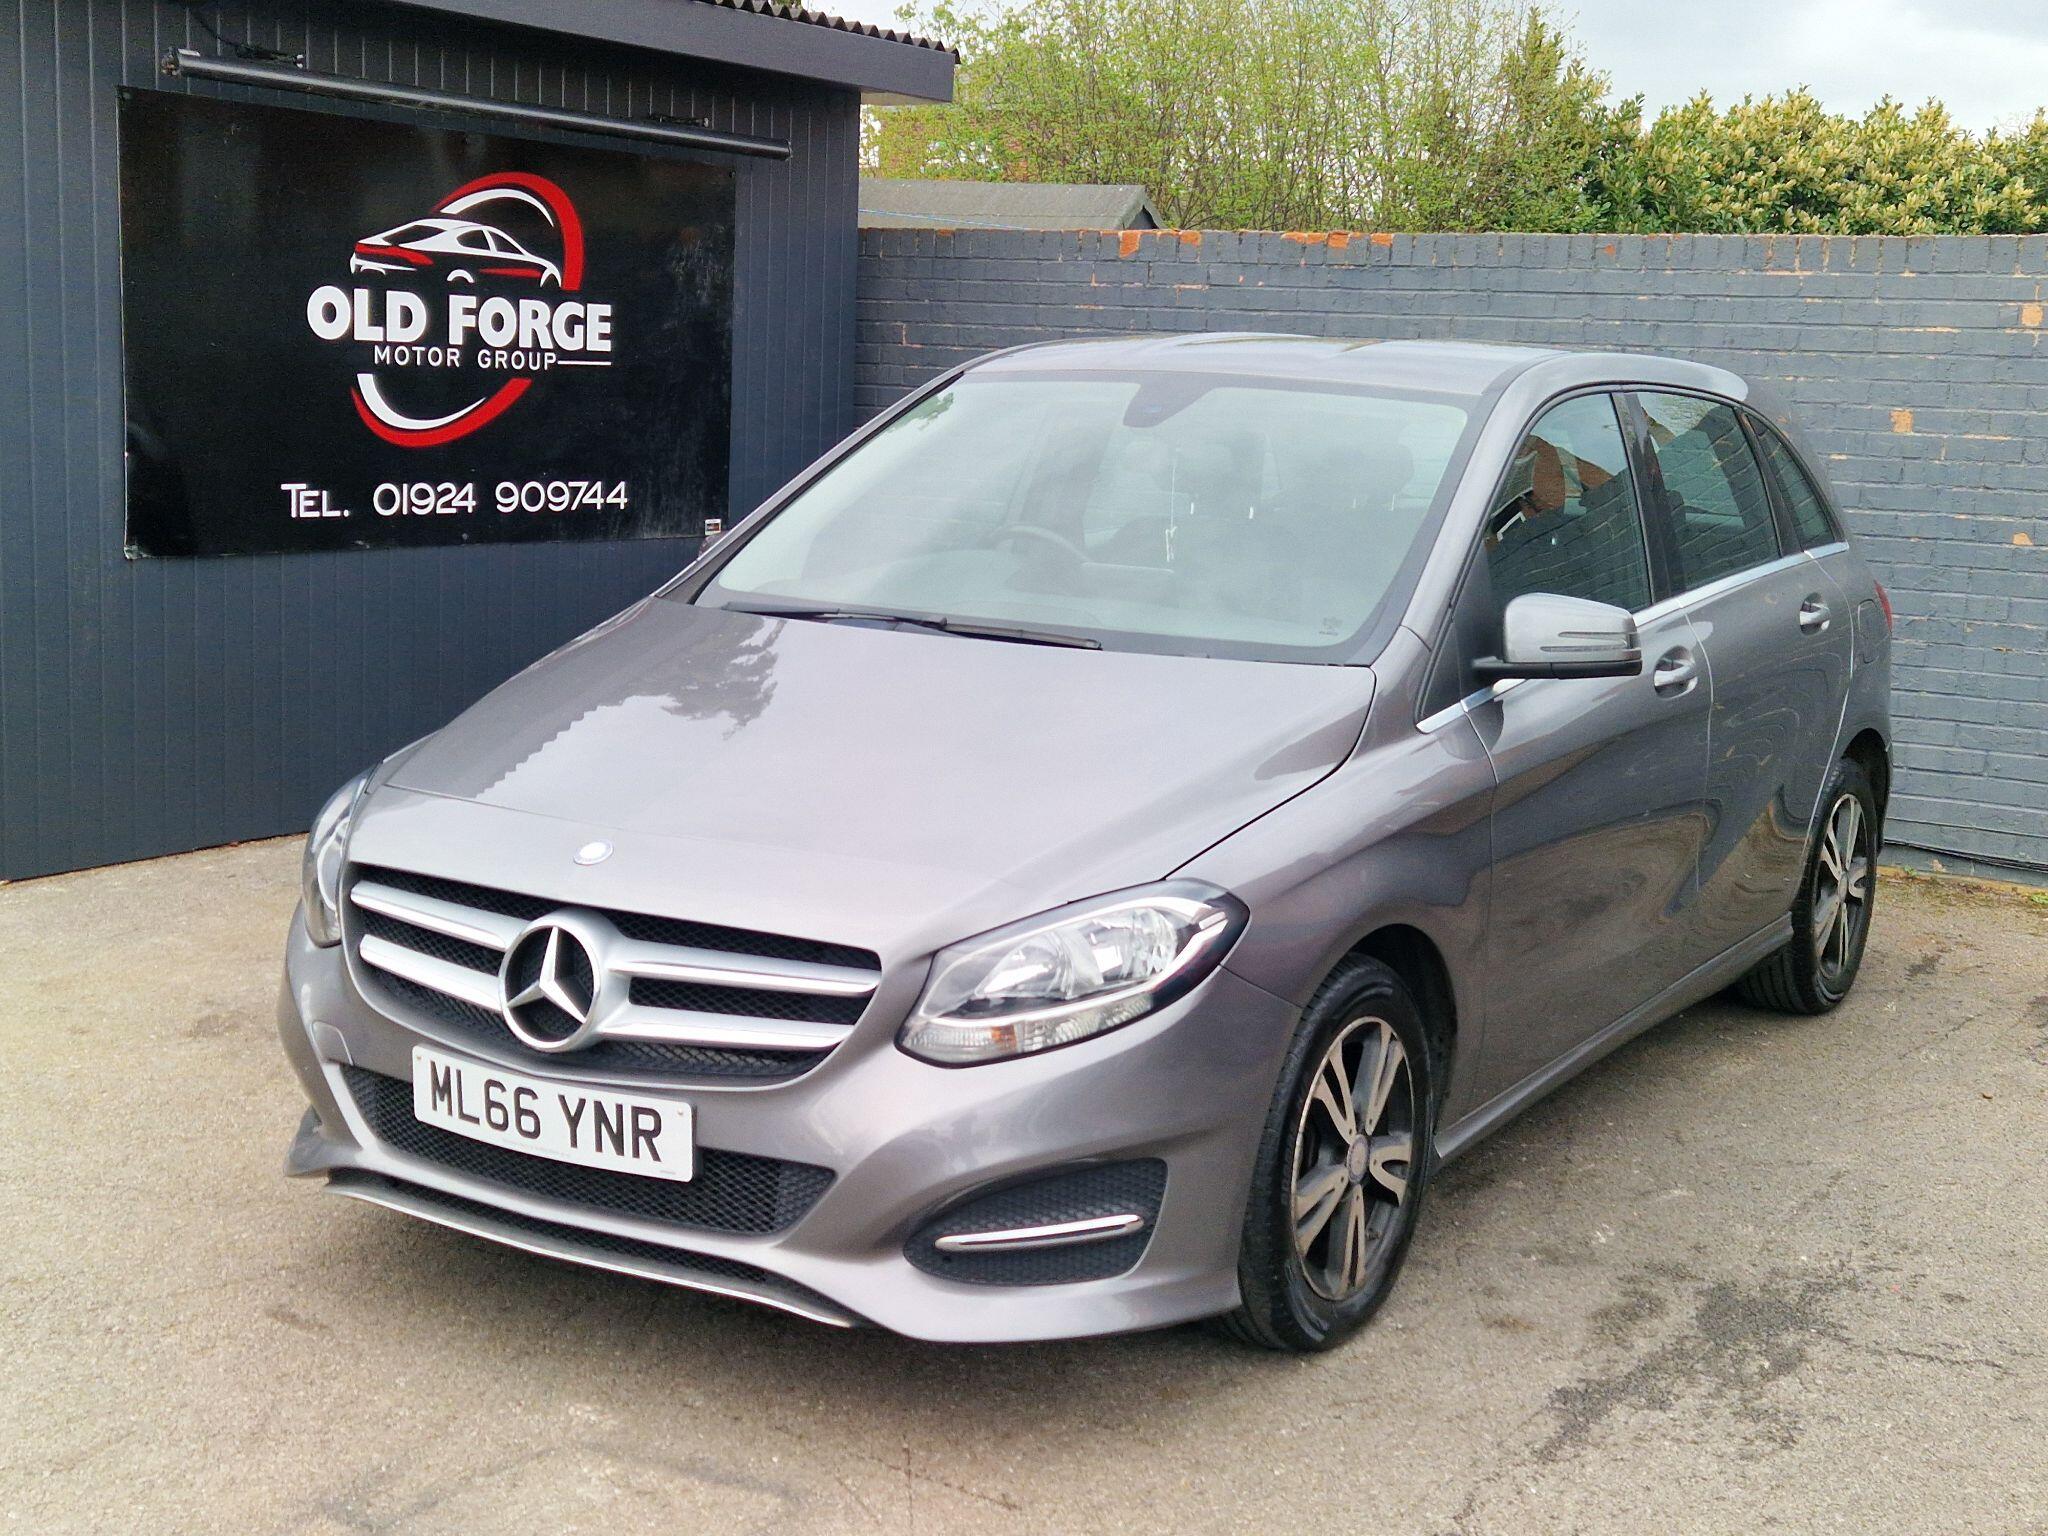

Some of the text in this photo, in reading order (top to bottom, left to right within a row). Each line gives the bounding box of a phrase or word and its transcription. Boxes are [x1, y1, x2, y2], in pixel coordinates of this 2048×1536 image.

[307, 286, 612, 352] OLD FORGE
[374, 345, 557, 371] MOTOR GROUP
[373, 482, 476, 515] 01924
[495, 480, 628, 513] 909744
[430, 1060, 662, 1163] ML66 YNR
